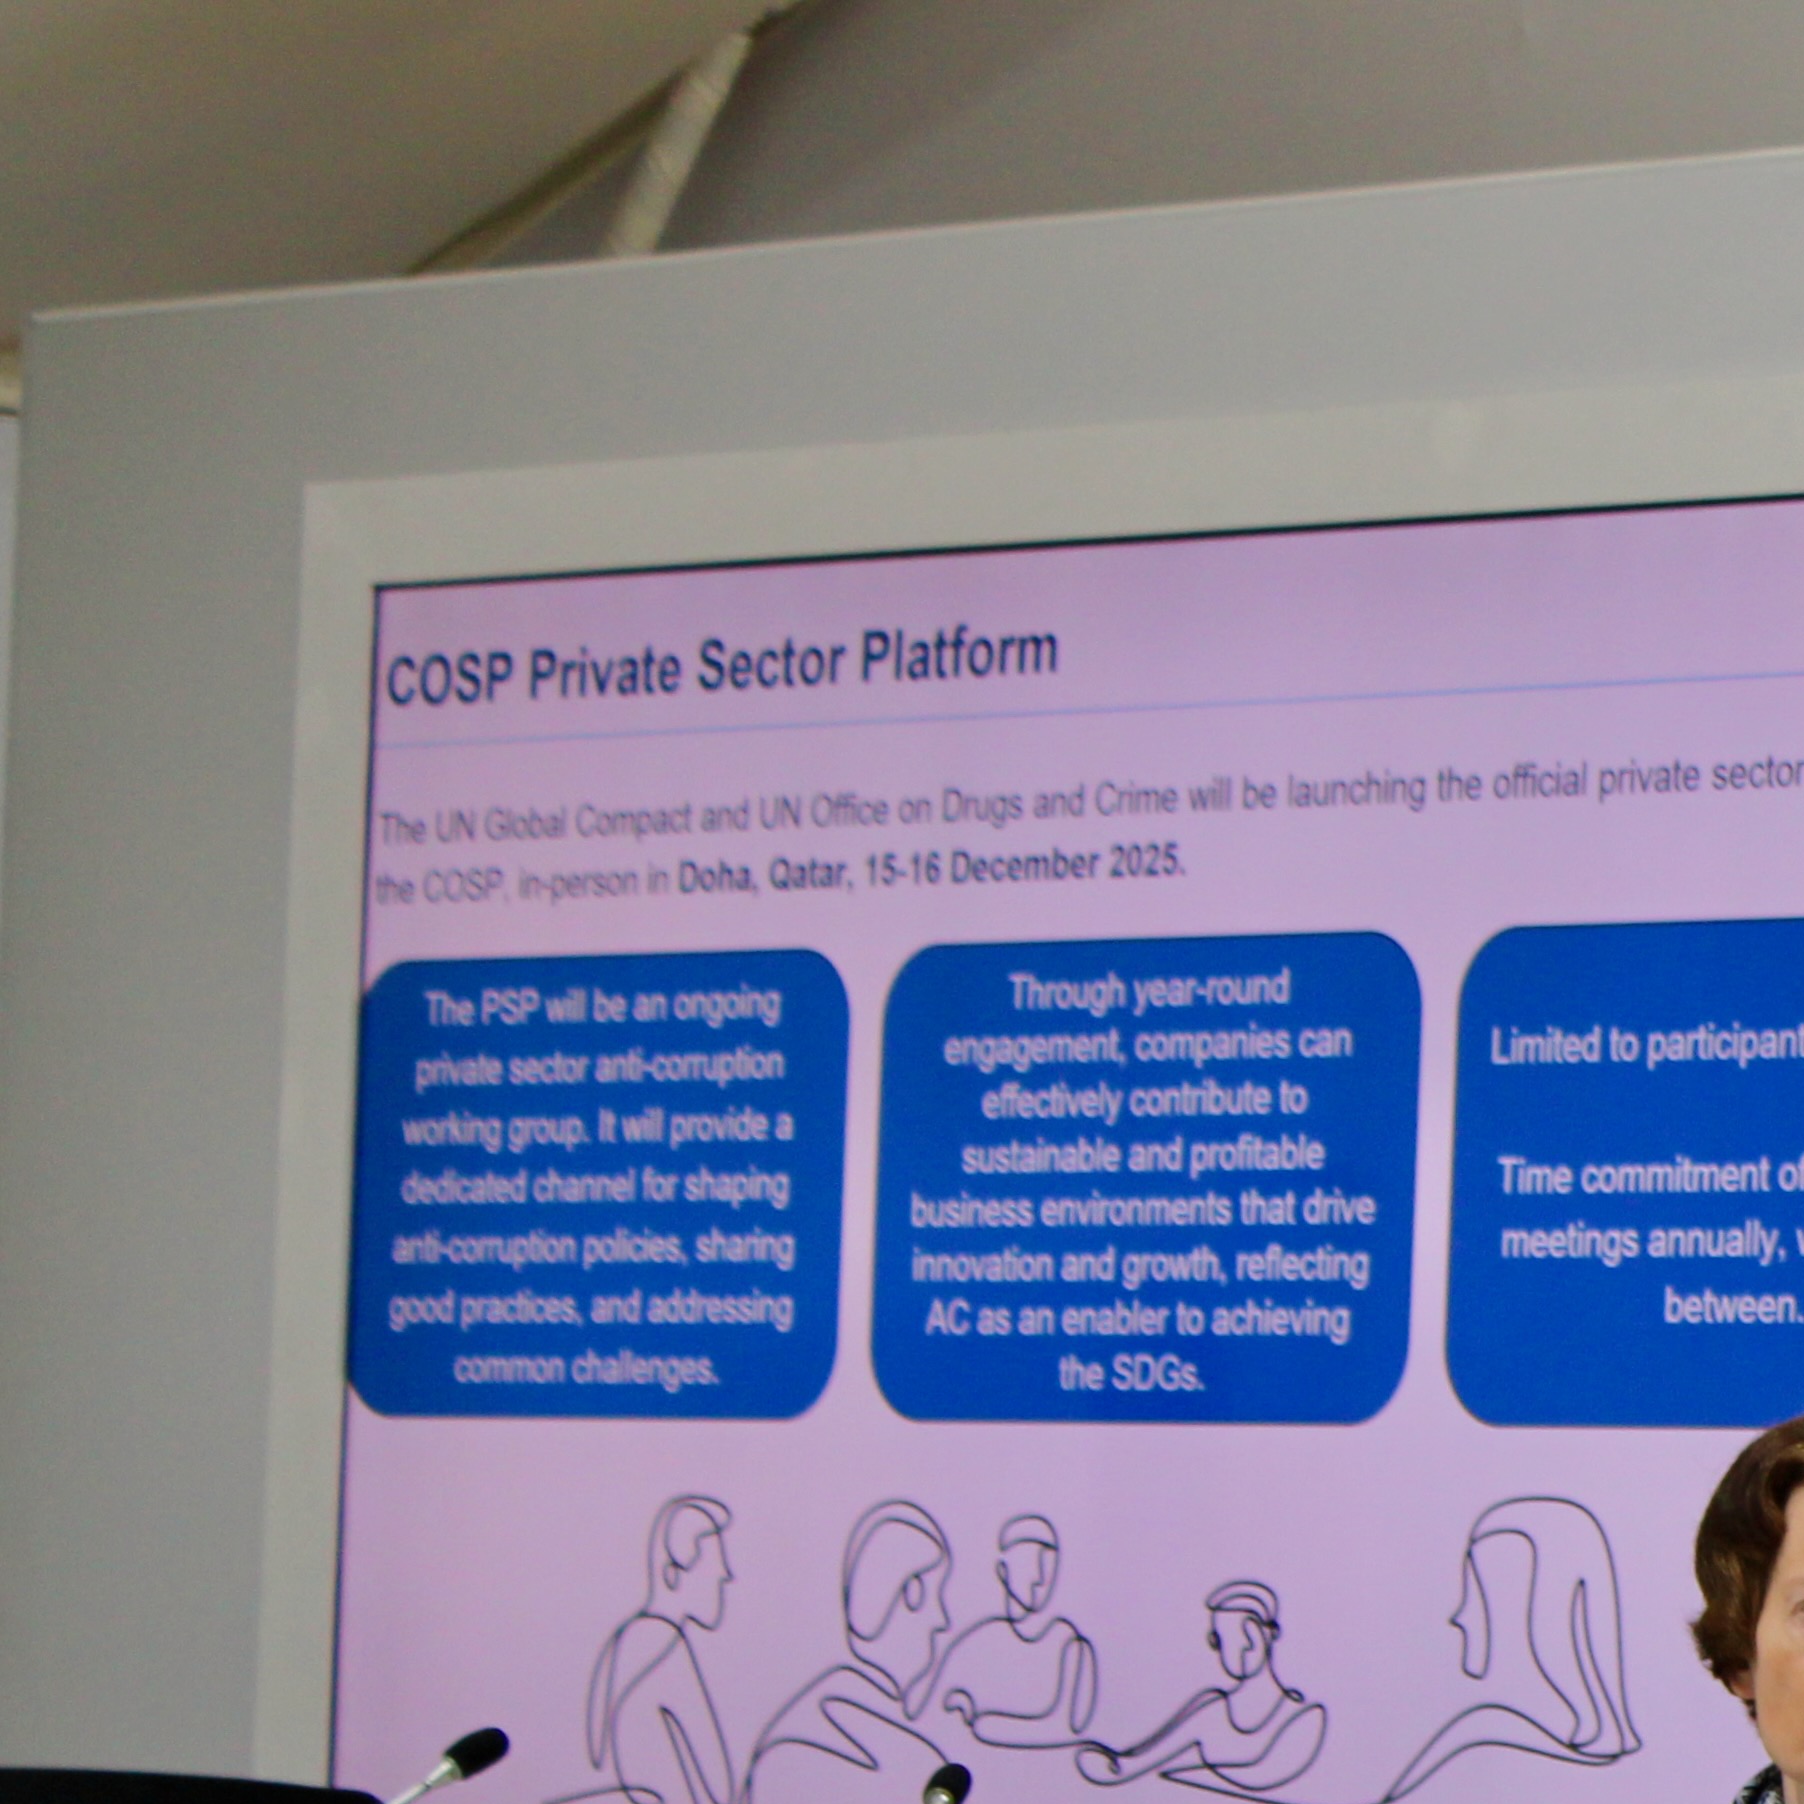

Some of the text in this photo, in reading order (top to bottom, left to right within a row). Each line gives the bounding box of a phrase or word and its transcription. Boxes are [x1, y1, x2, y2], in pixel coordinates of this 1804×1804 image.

[386, 624, 1057, 707] COSP Private Sector Platform
[379, 810, 426, 845] The
[436, 810, 476, 843] UN
[484, 806, 567, 841] Global
[575, 802, 693, 841] Compact
[700, 798, 750, 832] and
[760, 795, 802, 830] UN
[810, 792, 889, 828] Office
[898, 798, 932, 824] on
[942, 786, 1024, 829] Drugs
[1033, 783, 1086, 819] and
[1094, 780, 1179, 816] Crime
[1188, 777, 1232, 811] will
[1242, 776, 1277, 810] be
[1288, 769, 1427, 813] launching
[1437, 767, 1482, 802] the
[1493, 762, 1587, 799] official
[1599, 760, 1700, 803] private
[375, 871, 415, 905] the
[519, 870, 639, 906] in-person
[646, 863, 670, 894] in
[679, 860, 758, 894] Doha,
[769, 856, 852, 891] Qatar,
[867, 851, 941, 886] 15-16
[951, 848, 1100, 884] December
[1110, 842, 1185, 878] 2025.
[425, 984, 782, 1028] The PSP will be an ongoing
[1009, 967, 1291, 1017] Through year-round
[944, 1022, 1353, 1073] engagement, companies can
[1491, 1025, 1602, 1064] Limited
[1609, 1027, 1640, 1062] to
[416, 1045, 785, 1092] private sector anti-corruption
[982, 1078, 1309, 1125] effectively contribute to
[403, 1106, 794, 1153] working group. It will provide a
[962, 1133, 1326, 1179] sustainable and profitable
[1498, 1156, 1574, 1194] Time
[1581, 1155, 1771, 1193] commitment
[401, 1166, 790, 1209] dedicated channel for shaping
[911, 1188, 1377, 1228] business environments that drive
[392, 1227, 795, 1271] anti-corruption policies, sharing
[1501, 1221, 1640, 1267] meetings
[1647, 1219, 1786, 1266] annually,
[912, 1243, 1370, 1290] innovation and growth, reflecting
[389, 1288, 794, 1332] good practices, and addressing
[926, 1298, 1351, 1345] AC as an enabler to achieving
[1664, 1286, 1804, 1323] between.
[454, 1349, 719, 1393] common challenges.
[1059, 1353, 1204, 1391] the SDGs.
